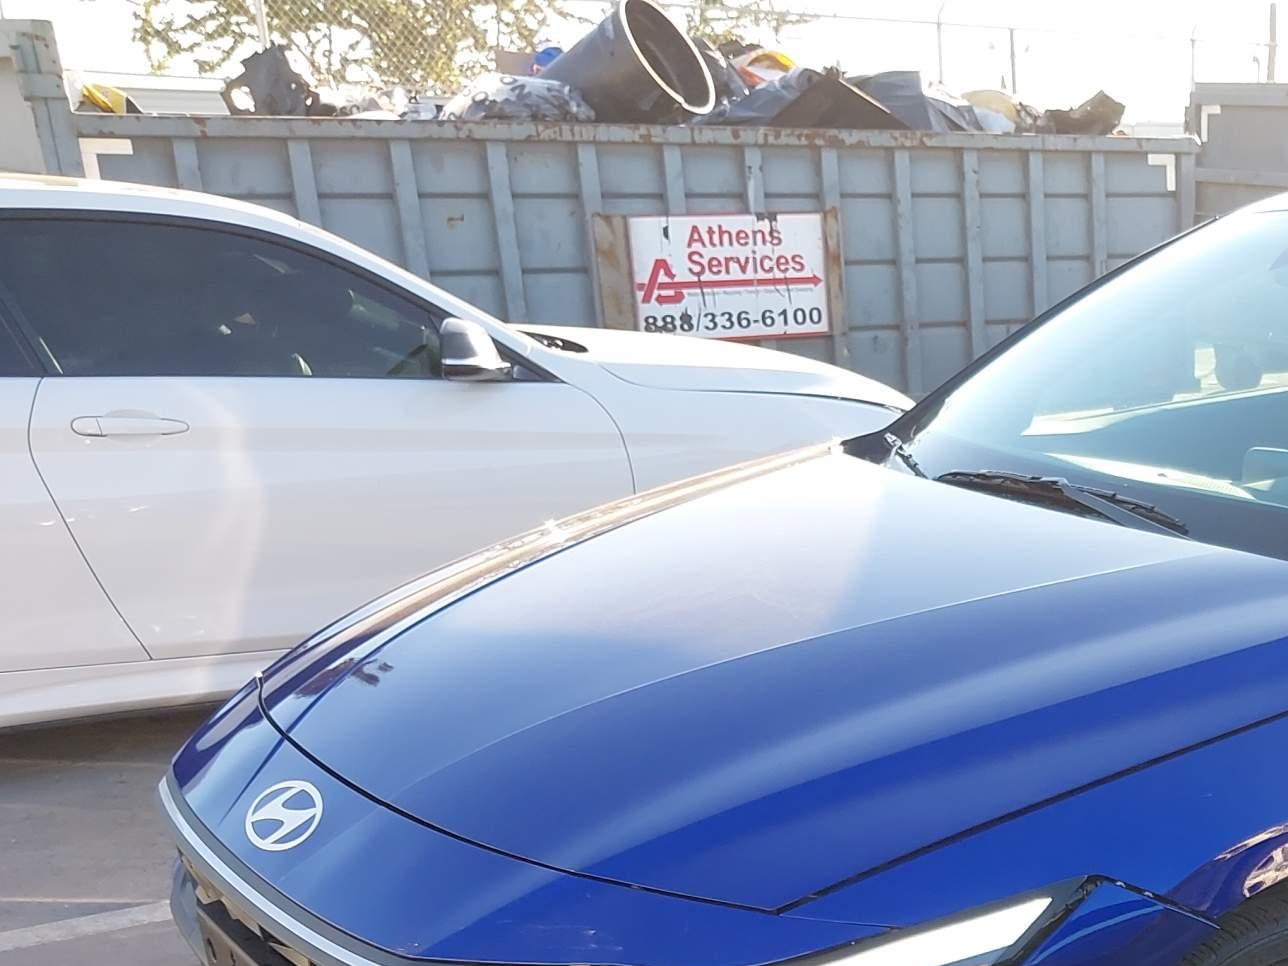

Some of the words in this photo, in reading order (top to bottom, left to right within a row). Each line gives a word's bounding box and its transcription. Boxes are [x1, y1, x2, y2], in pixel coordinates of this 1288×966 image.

[686, 224, 783, 249] Athens
[687, 250, 805, 277] Services
[643, 306, 823, 334] 888/336-6100
